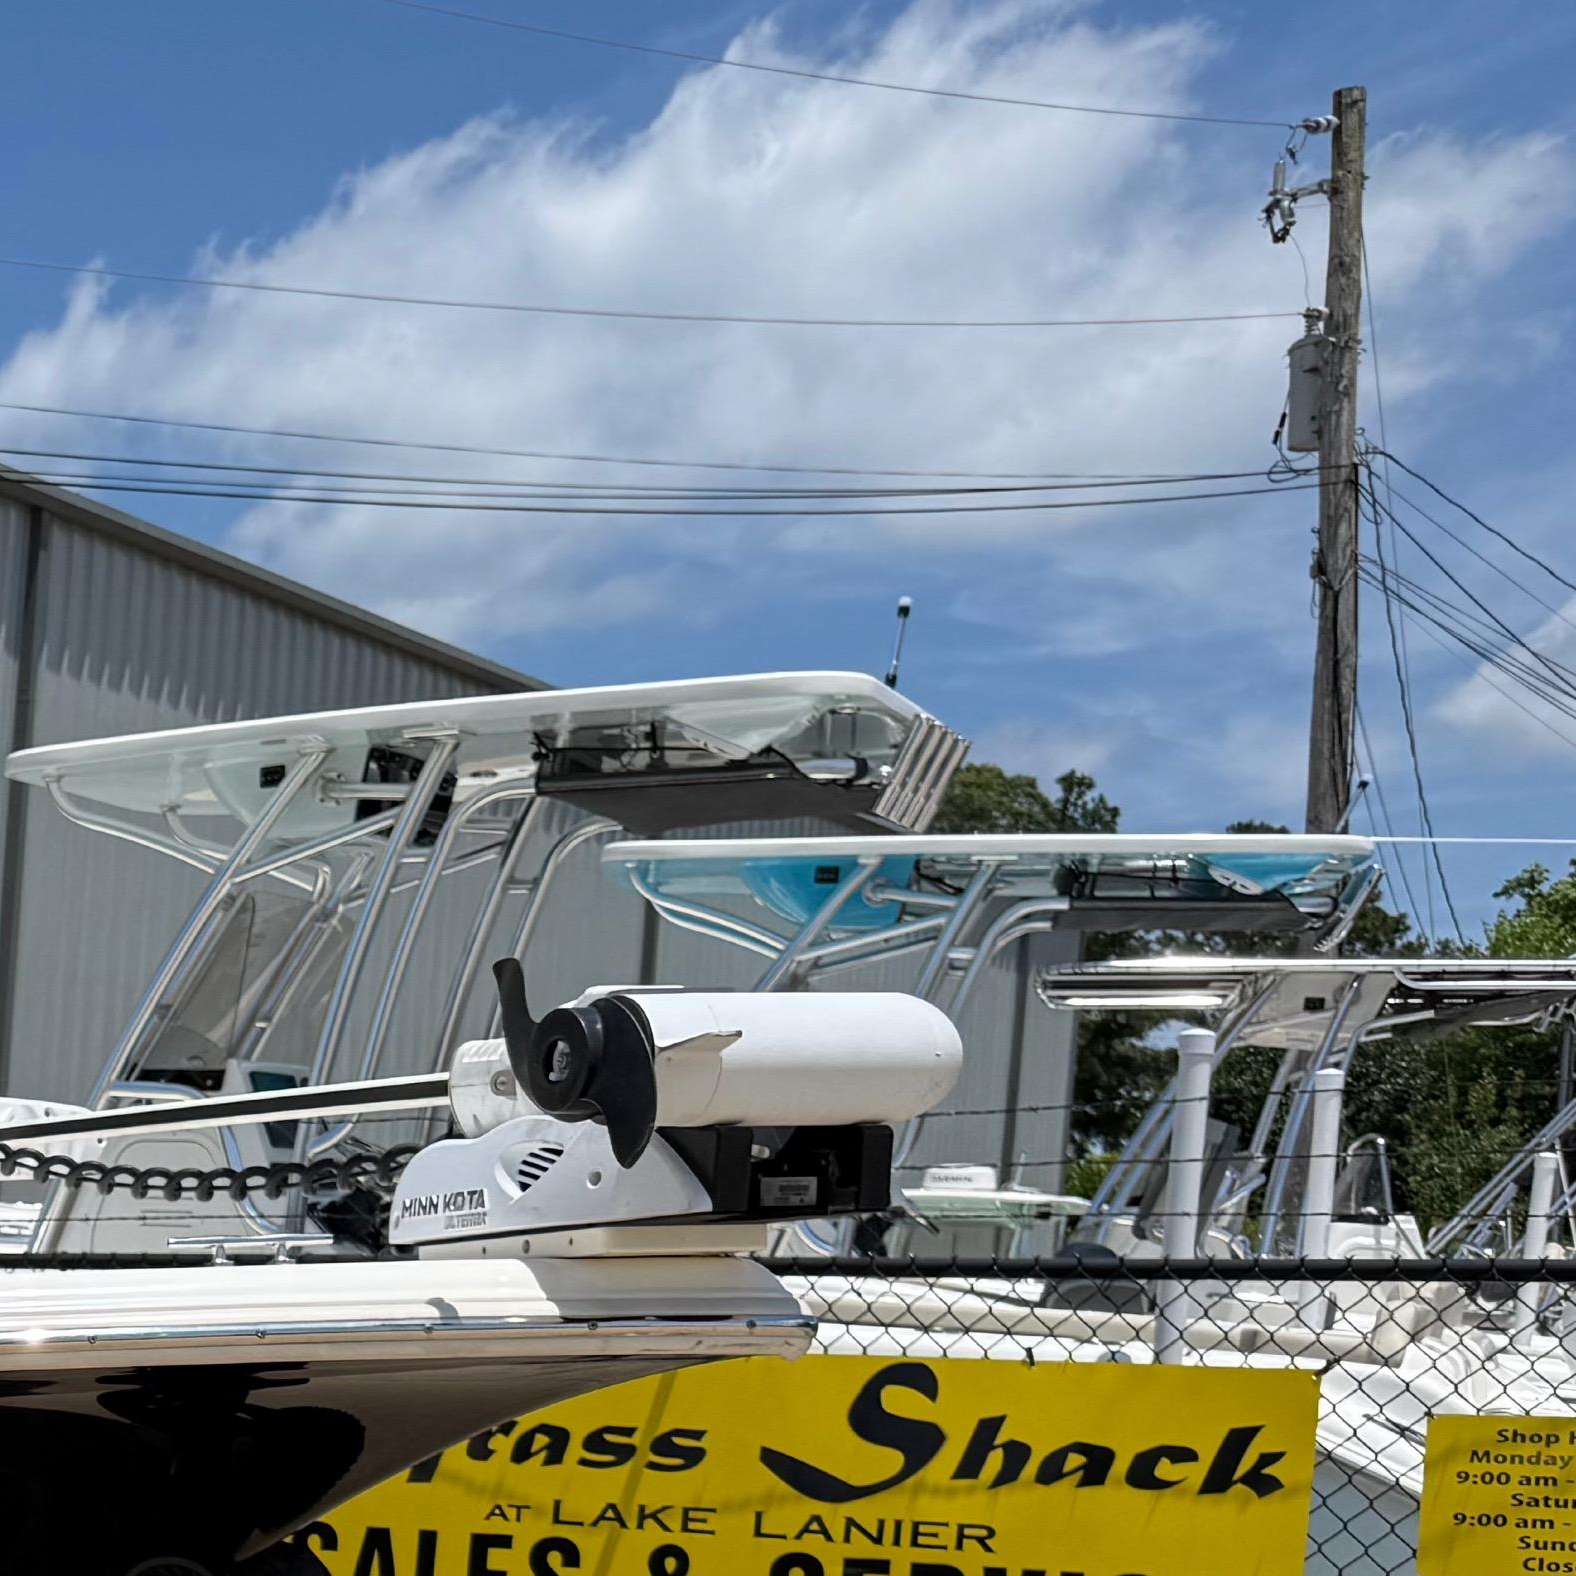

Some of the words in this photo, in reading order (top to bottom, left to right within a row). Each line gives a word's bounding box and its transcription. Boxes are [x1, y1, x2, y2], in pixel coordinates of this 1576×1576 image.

[401, 1194, 440, 1219] MINN
[443, 1188, 486, 1214] KOTA
[407, 1420, 707, 1483] rass
[759, 1362, 1286, 1504] Shack
[1496, 1428, 1560, 1448] Shop
[1469, 1450, 1574, 1470] Monday
[1456, 1471, 1511, 1486] 9:00
[1517, 1475, 1558, 1487] am
[486, 1504, 531, 1522] AT
[552, 1499, 717, 1535] LAKE
[754, 1511, 996, 1553] LANIER
[1453, 1512, 1508, 1528] 9:00
[1514, 1517, 1555, 1530] am
[1522, 1557, 1576, 1573] Clos
